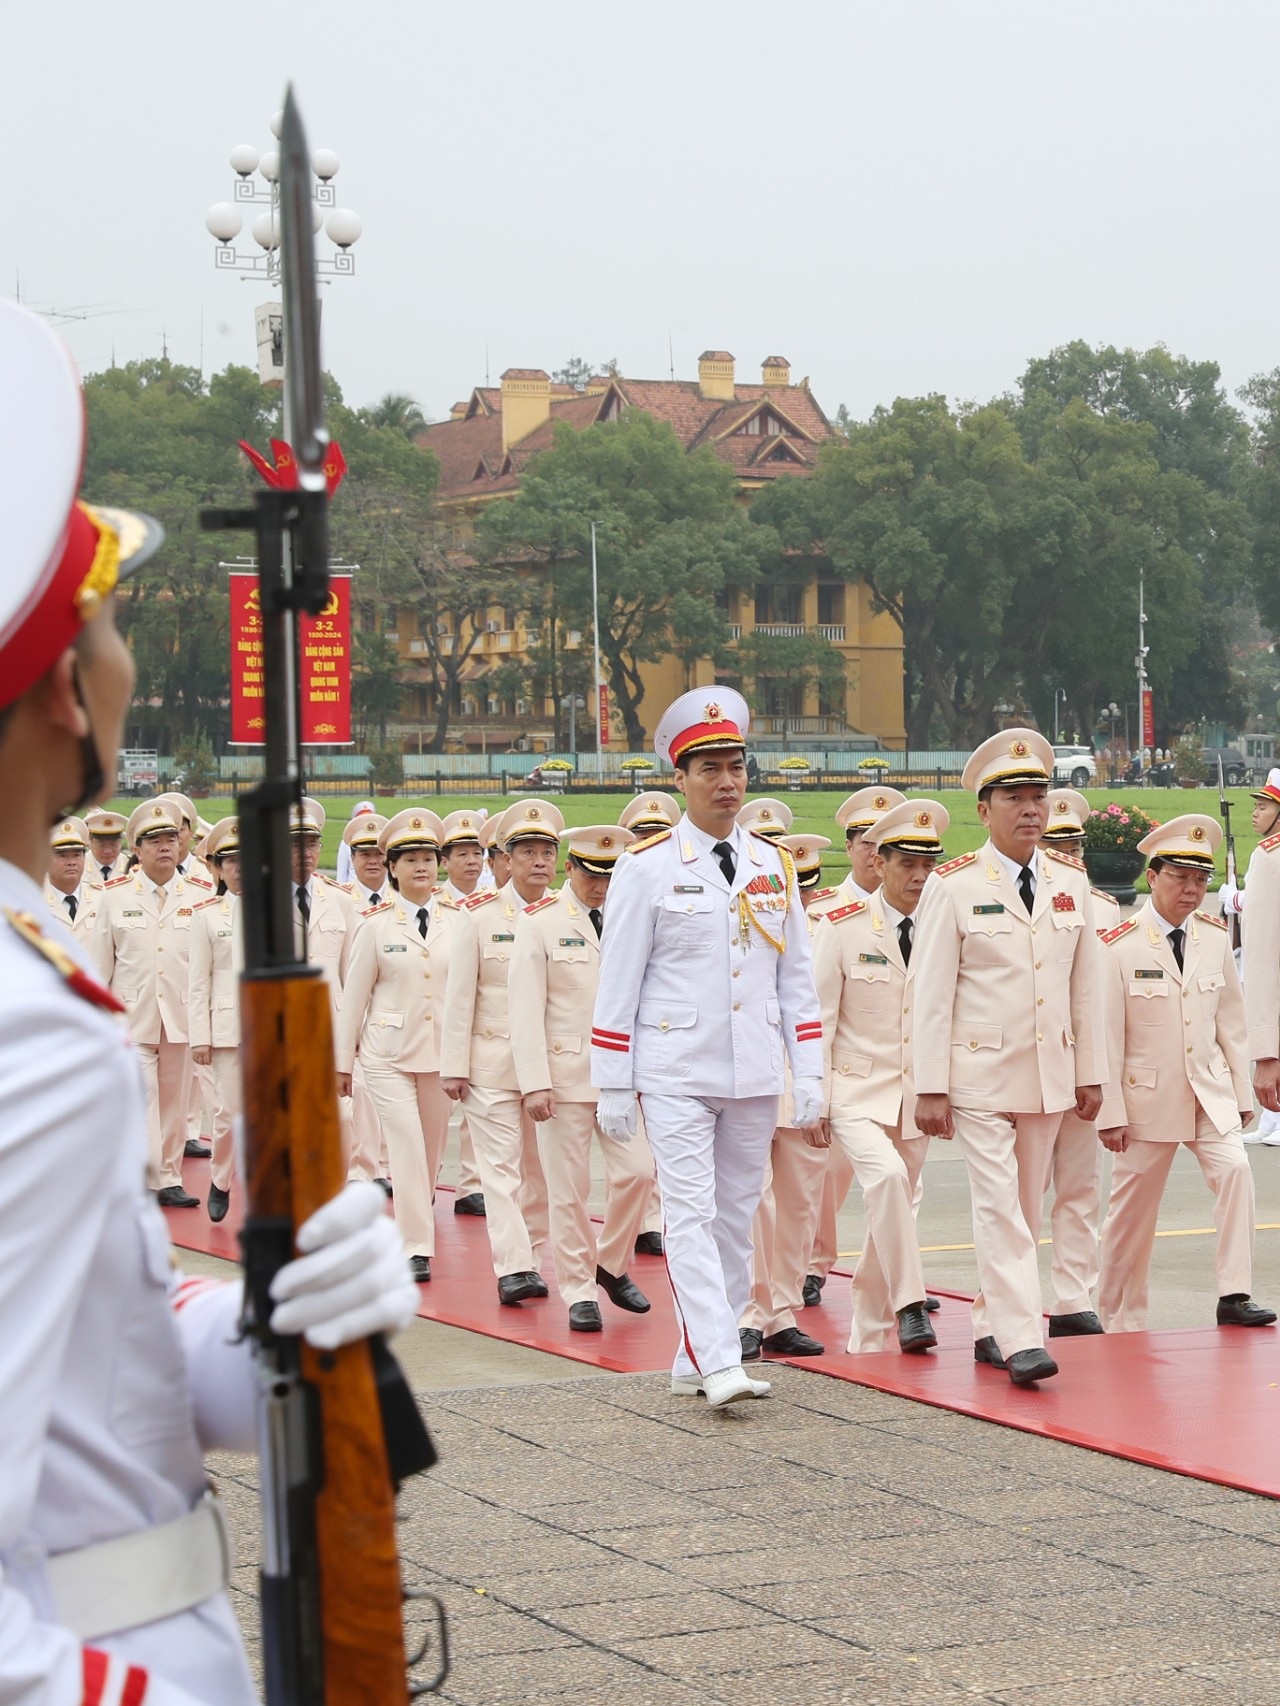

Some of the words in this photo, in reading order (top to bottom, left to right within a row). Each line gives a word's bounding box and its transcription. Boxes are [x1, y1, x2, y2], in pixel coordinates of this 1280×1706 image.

[316, 621, 333, 630] 3-2
[305, 643, 318, 656] ĐẢNG
[319, 645, 332, 658] CỘNG
[333, 642, 344, 656] SẢN
[246, 655, 257, 669] VIỆT
[313, 660, 322, 673] VIỆT
[323, 662, 335, 671] NAM
[243, 672, 260, 683] QUANG
[310, 677, 326, 687] QUANG
[327, 677, 338, 686] VINH
